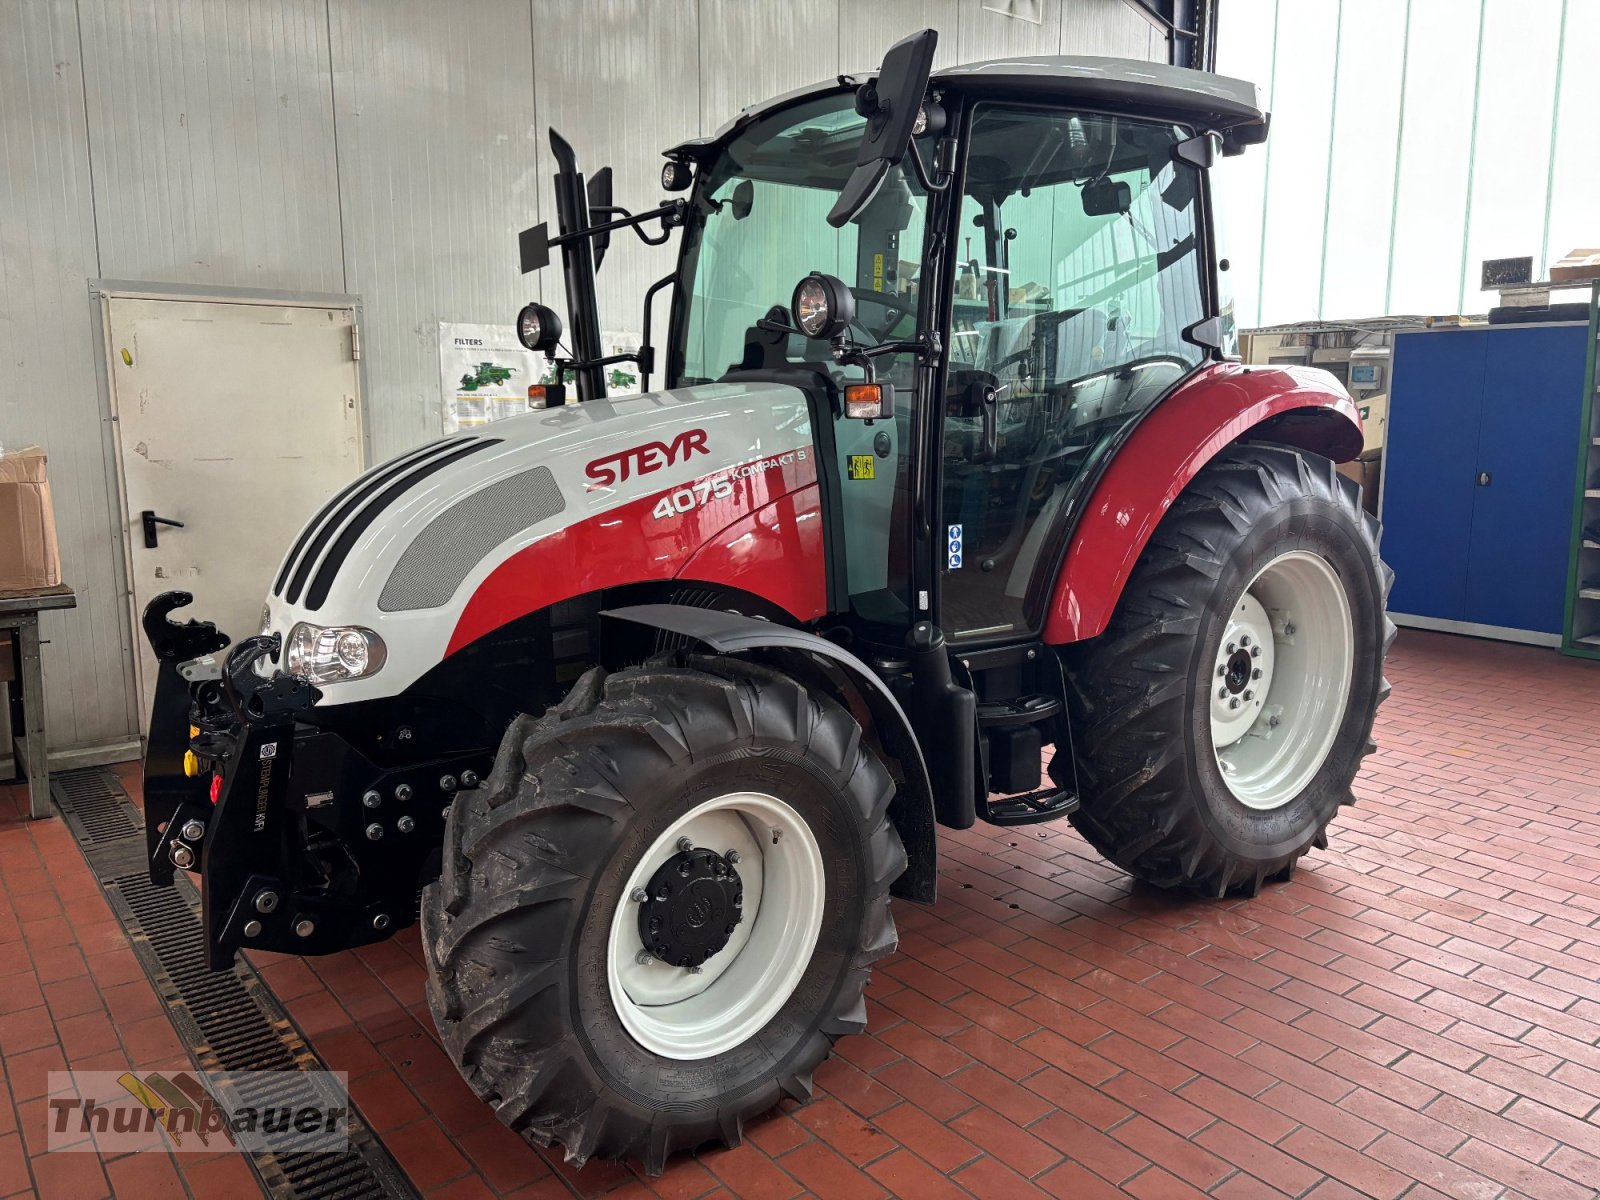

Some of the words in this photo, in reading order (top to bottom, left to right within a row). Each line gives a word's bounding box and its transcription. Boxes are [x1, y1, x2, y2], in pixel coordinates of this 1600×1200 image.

[454, 338, 483, 346] FILTERS
[585, 428, 711, 493] STEYR
[652, 476, 734, 520] 4075
[731, 455, 795, 481] KOMPAKT
[797, 451, 807, 462] S
